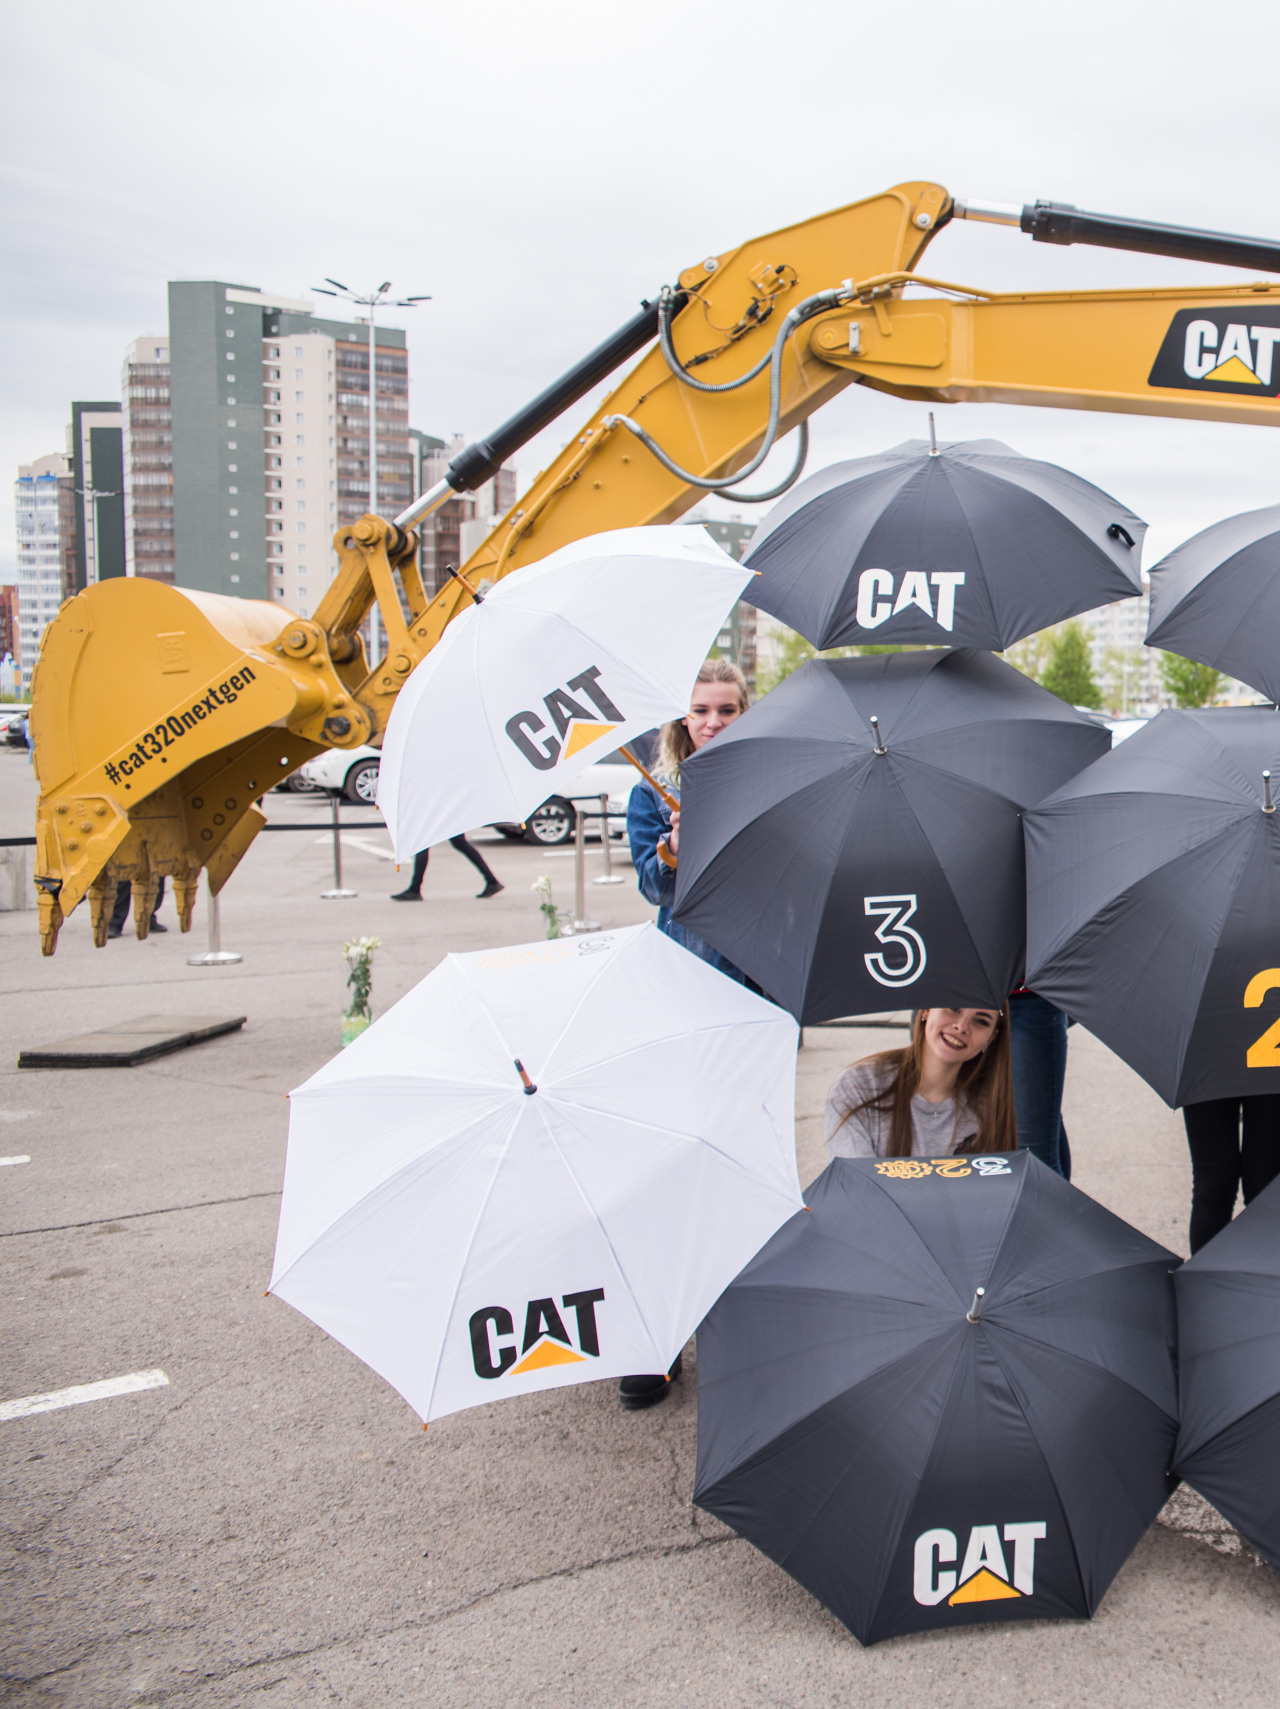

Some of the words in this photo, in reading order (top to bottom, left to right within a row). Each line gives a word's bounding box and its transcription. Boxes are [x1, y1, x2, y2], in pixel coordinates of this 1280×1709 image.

[856, 568, 966, 632] CAT
[104, 665, 257, 786] #cat320nextgen
[505, 664, 627, 771] CAT
[863, 893, 928, 988] 3
[468, 1287, 606, 1380] CAT
[912, 1520, 1048, 1607] CAT
